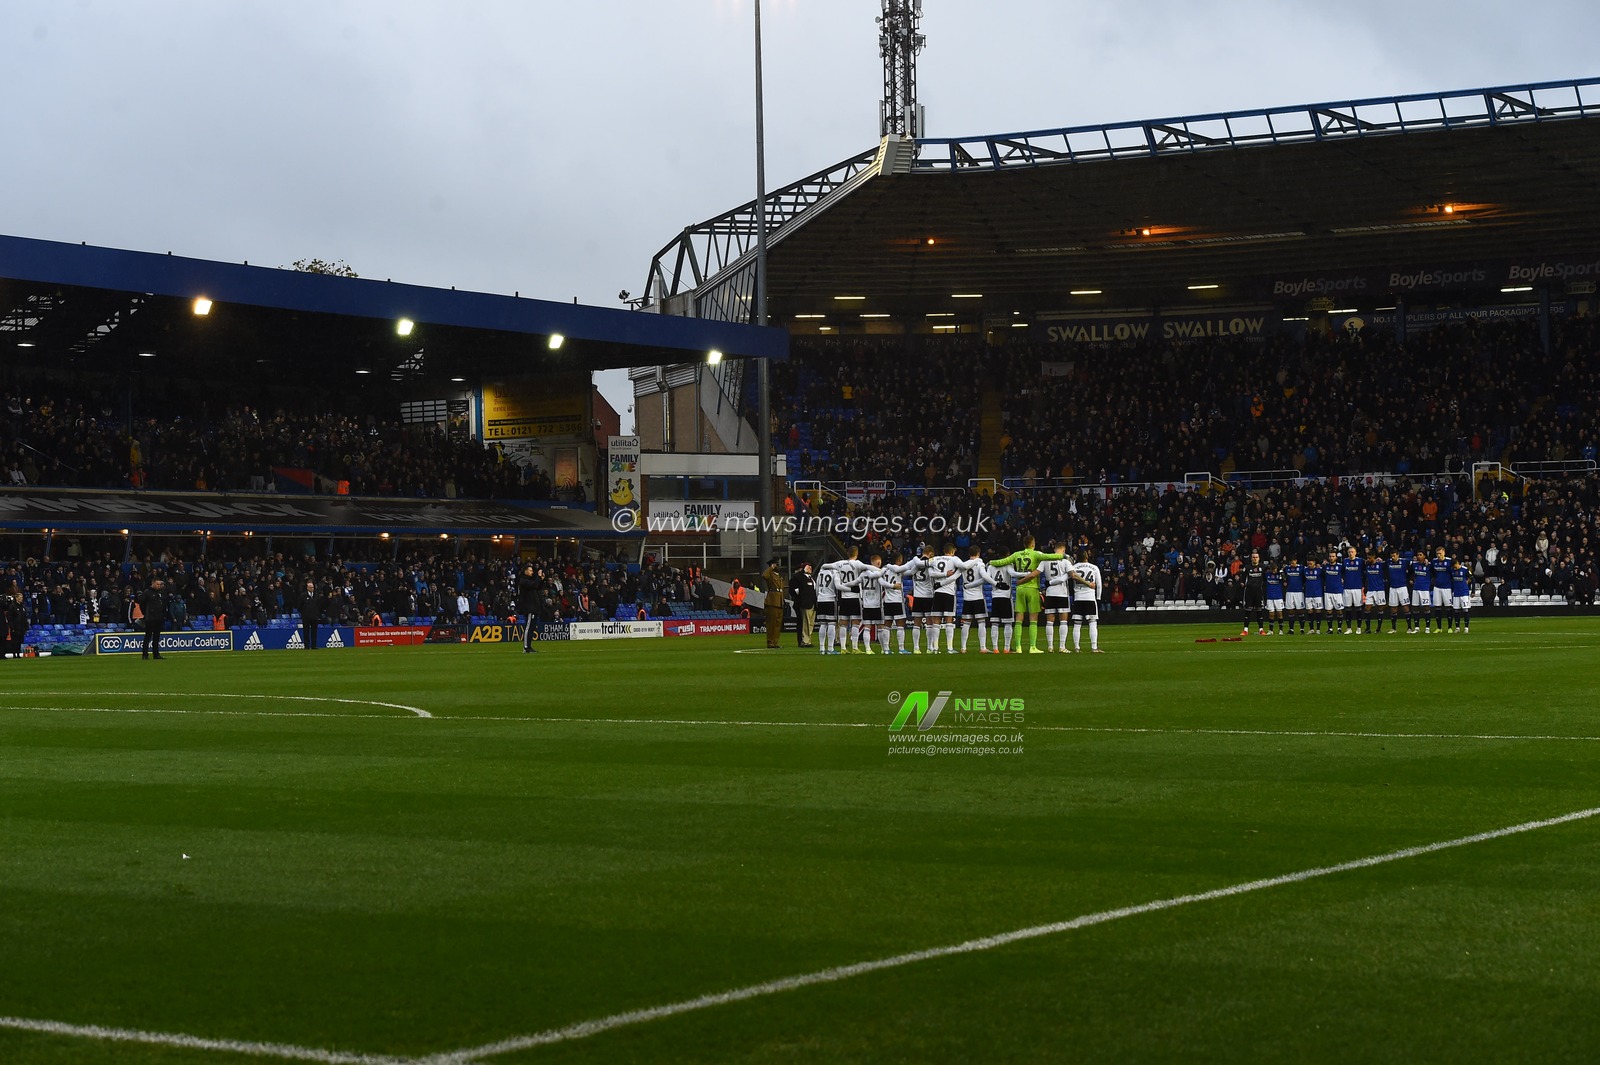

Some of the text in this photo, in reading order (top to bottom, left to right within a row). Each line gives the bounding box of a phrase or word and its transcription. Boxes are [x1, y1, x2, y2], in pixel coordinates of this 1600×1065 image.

[1389, 269, 1486, 289] BoyleSports
[1273, 276, 1367, 296] BoyleSports
[1436, 312, 1447, 320] OF
[1449, 311, 1464, 319] ALL
[1465, 310, 1488, 319] YOUR
[1489, 308, 1535, 317] PACKAGING
[1047, 323, 1150, 341] SWALLOW
[1163, 317, 1264, 338] SWALLOW
[610, 454, 639, 463] FAMILY
[684, 504, 722, 516] FAMILY
[937, 561, 946, 573] 9
[1016, 558, 1031, 572] 12
[1050, 562, 1058, 577] 5
[820, 573, 832, 587] 19
[841, 571, 855, 584] 20
[967, 568, 975, 582] 8
[864, 576, 876, 590] 21
[544, 624, 563, 632] B'HAM
[601, 622, 627, 634] traffix
[678, 622, 695, 633] rush
[733, 623, 746, 631] PARK
[470, 626, 502, 643] A2B
[540, 632, 570, 641] COVENTRY
[167, 637, 193, 647] Colour
[194, 636, 229, 649] Coatings
[326, 640, 344, 648] adidas
